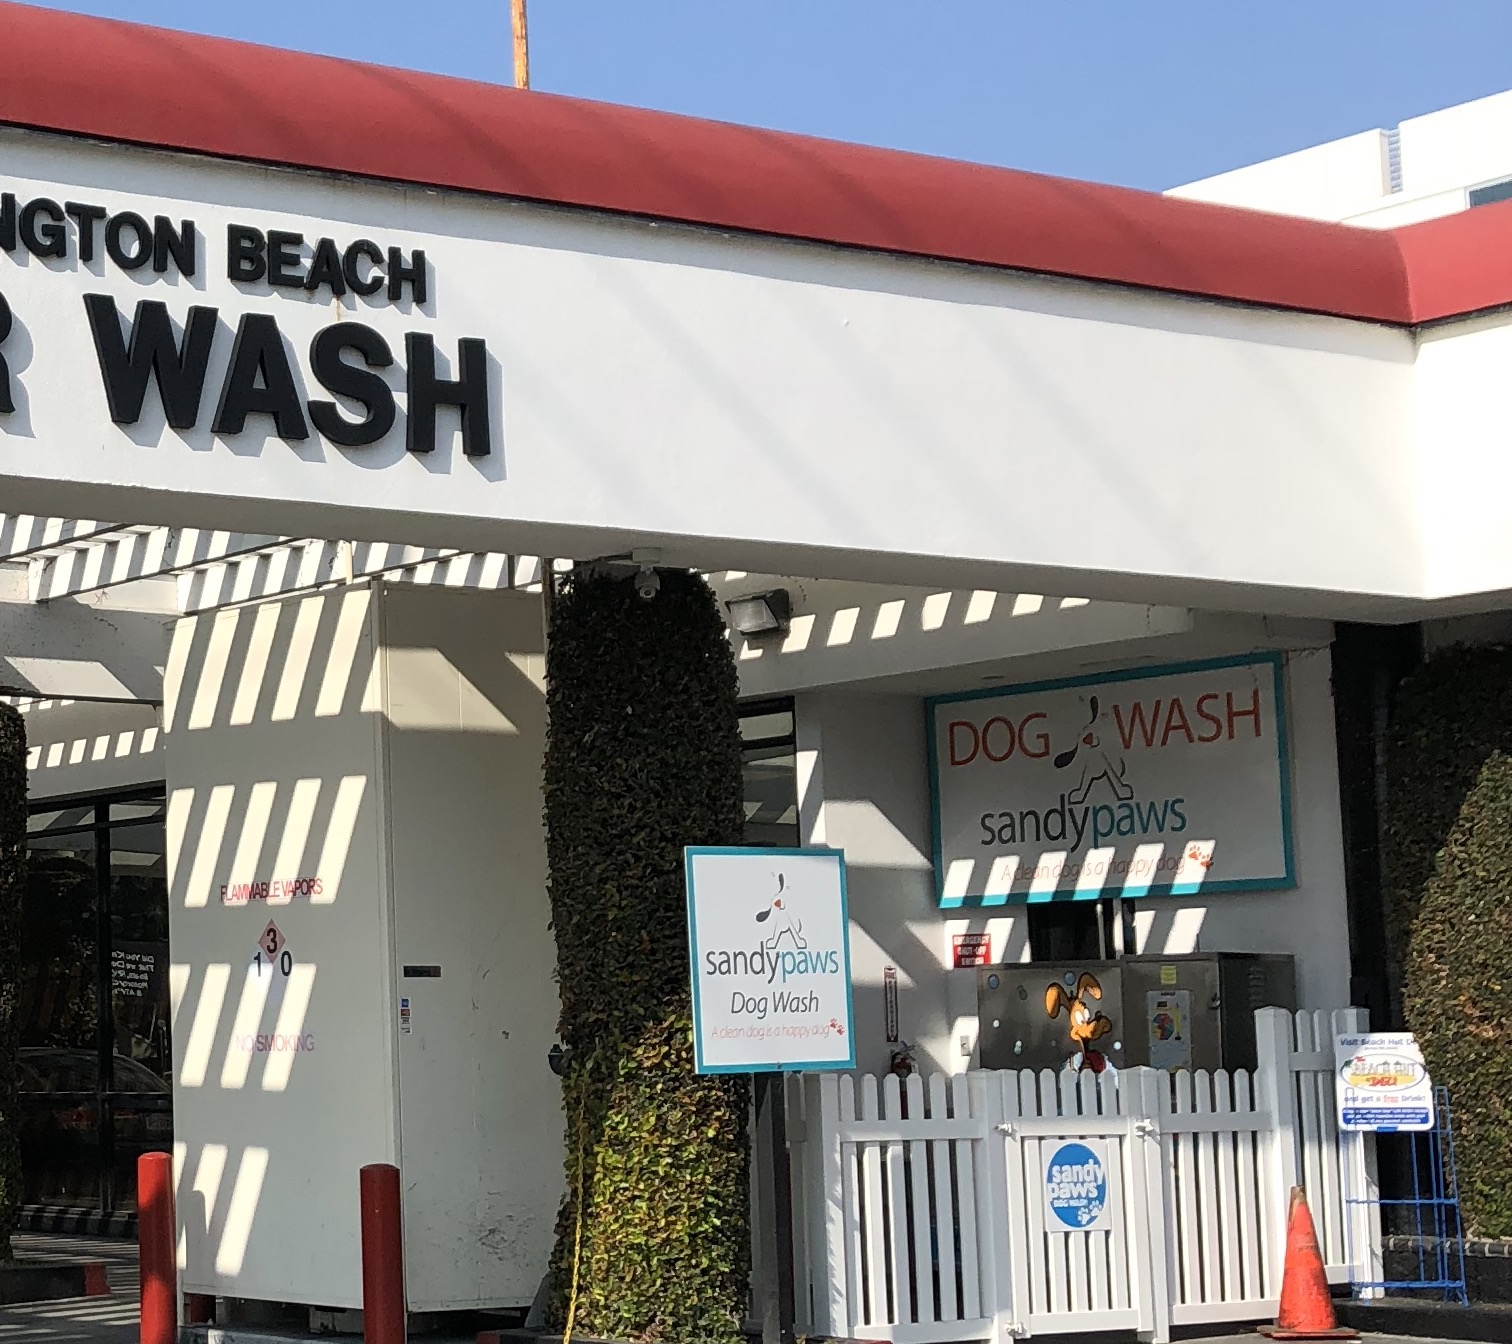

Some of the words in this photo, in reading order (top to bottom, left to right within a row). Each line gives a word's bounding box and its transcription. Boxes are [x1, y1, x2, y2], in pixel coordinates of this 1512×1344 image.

[227, 223, 427, 305] BEACH
[82, 293, 491, 457] WASH
[948, 712, 1050, 766] DOG
[1112, 687, 1262, 750] WASH
[980, 793, 1188, 853] sandypaws
[1001, 864, 1013, 881] A
[1013, 859, 1050, 881] clean
[1052, 856, 1080, 882] dog
[1081, 858, 1092, 877] is
[1094, 860, 1105, 876] a
[1106, 854, 1155, 880] happy
[1157, 852, 1185, 876] dog
[220, 881, 280, 902] FLAMMABLE
[281, 878, 324, 899] VAPORS
[266, 927, 278, 953] 3
[253, 951, 262, 977] 1
[280, 950, 293, 977] 0
[706, 941, 840, 984] sandypaws
[731, 991, 768, 1020] Dog
[772, 989, 820, 1014] Wash
[236, 1035, 253, 1052] NO
[256, 1033, 315, 1053] SMOKING
[711, 1025, 719, 1038] A
[719, 1024, 746, 1039] clean
[747, 1024, 765, 1040] dog
[766, 1024, 773, 1038] is
[774, 1027, 781, 1037] a
[781, 1023, 811, 1040] happy
[812, 1023, 830, 1039] dog
[1340, 1038, 1358, 1046] Visit
[1360, 1038, 1385, 1046] Beach
[1353, 1062, 1391, 1074] BEACH
[1052, 1159, 1106, 1185] sandy
[1047, 1182, 1099, 1201] paws
